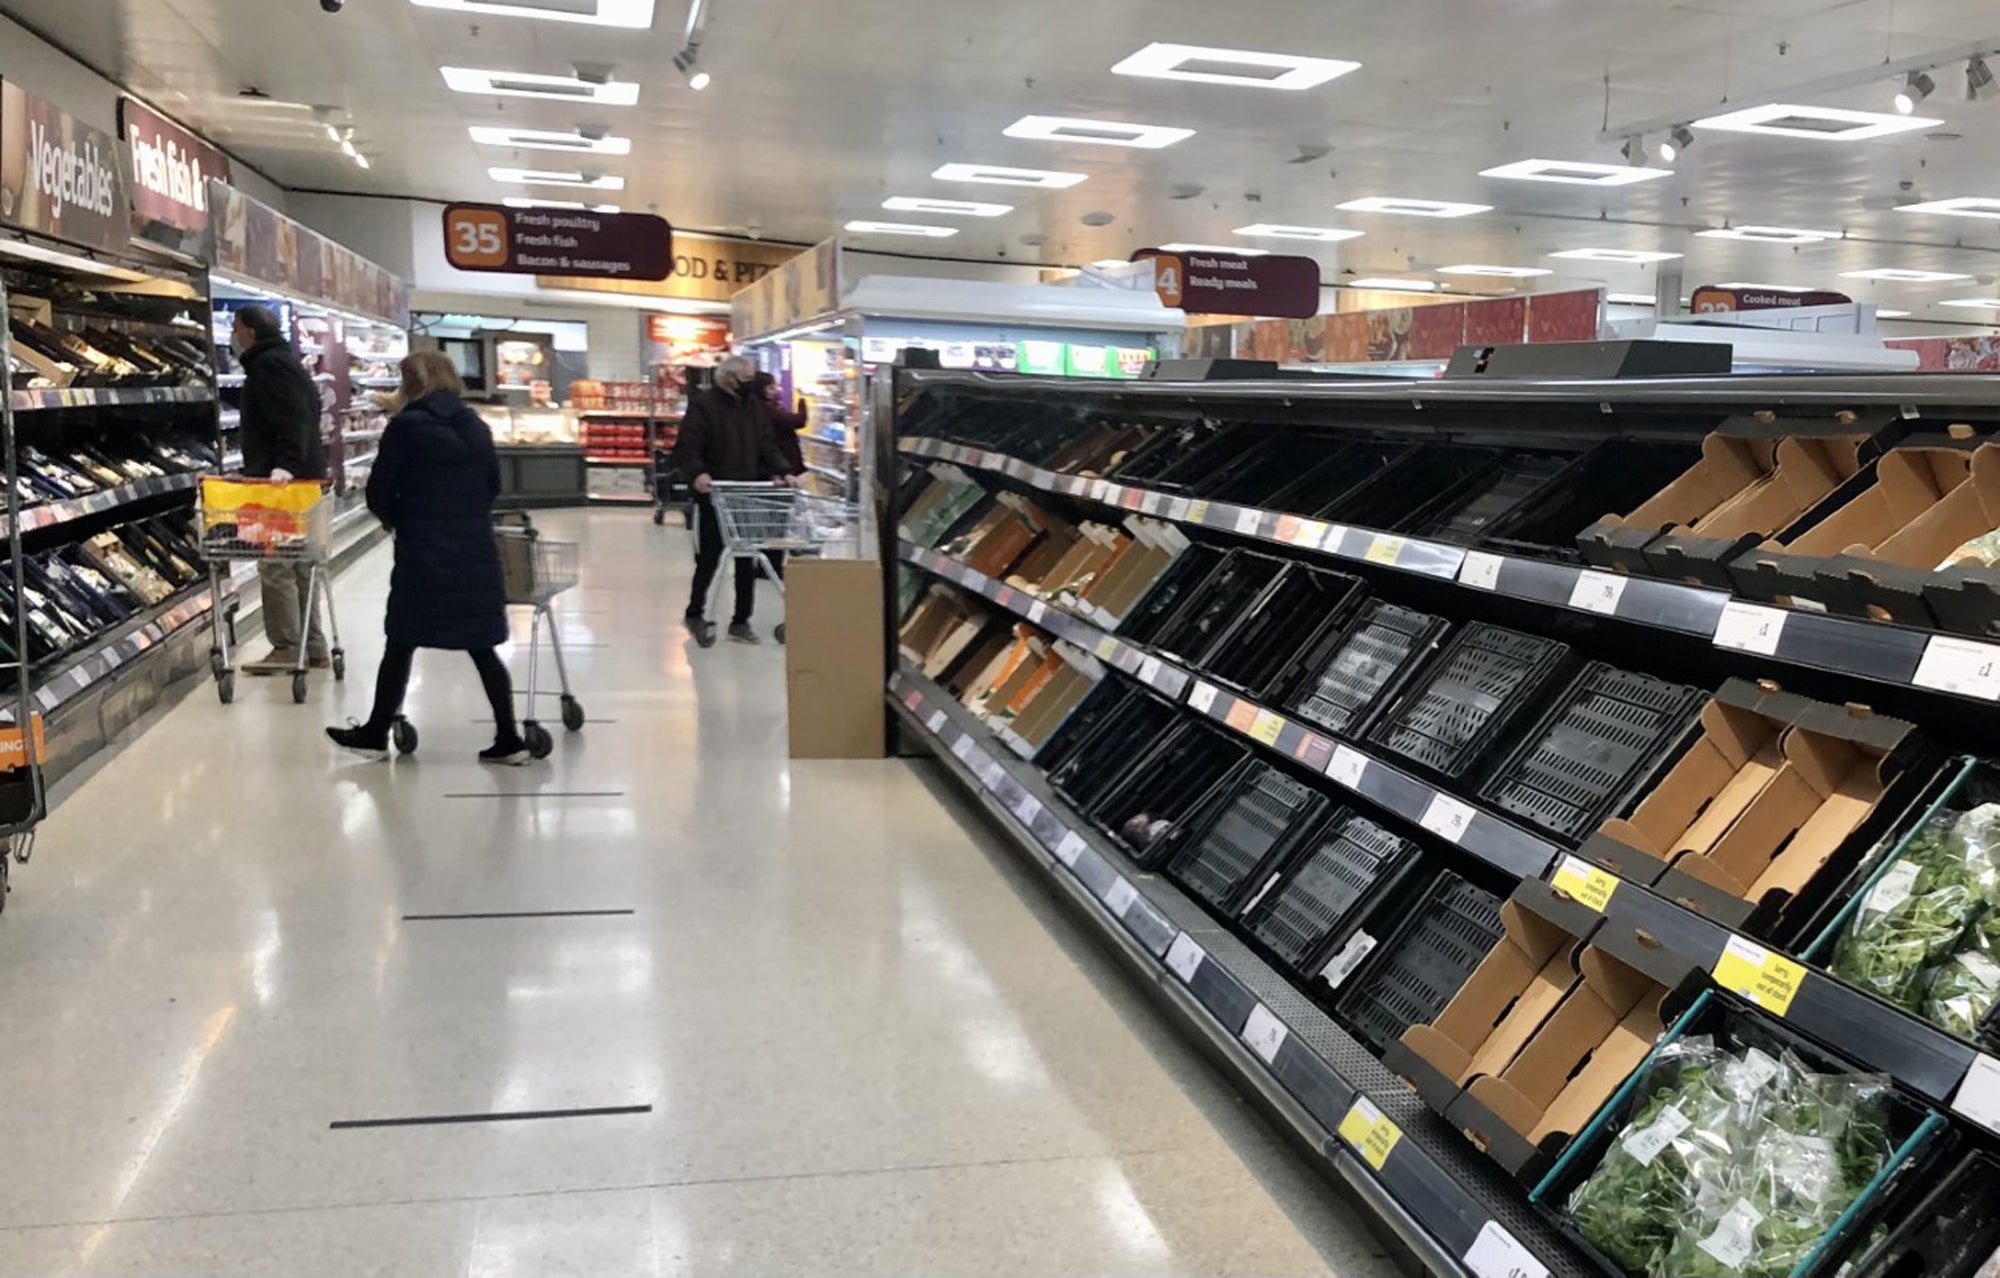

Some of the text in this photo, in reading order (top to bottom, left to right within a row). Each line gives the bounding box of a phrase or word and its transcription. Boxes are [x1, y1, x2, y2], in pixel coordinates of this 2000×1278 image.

[31, 119, 113, 218] Vegetables
[129, 123, 168, 197] Fresh
[167, 139, 193, 207] fish
[192, 157, 204, 211] &
[515, 212, 600, 232] Fresh poultry
[456, 222, 501, 253] 35
[515, 233, 578, 247] Fresh fish
[517, 253, 631, 273] Bacon & sausages
[713, 260, 728, 281] &
[1189, 256, 1249, 270] Fresh meat
[1189, 275, 1223, 290] Ready
[1743, 294, 1777, 305] Cooked
